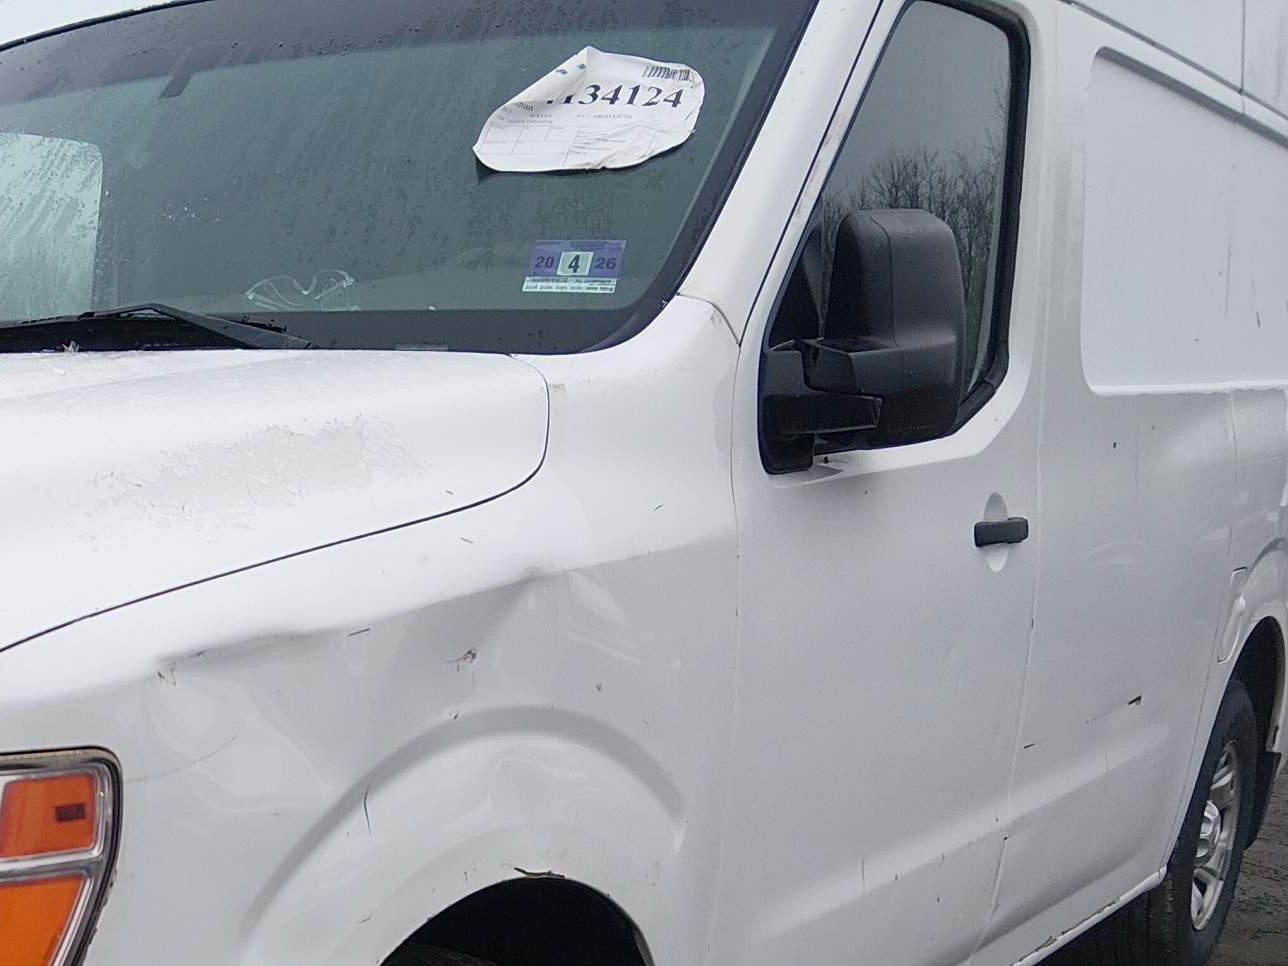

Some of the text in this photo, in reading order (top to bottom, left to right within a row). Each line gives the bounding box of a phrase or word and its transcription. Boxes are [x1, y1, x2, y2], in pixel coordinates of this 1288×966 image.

[546, 84, 684, 108] 134124
[535, 254, 617, 273] 20 4 26
